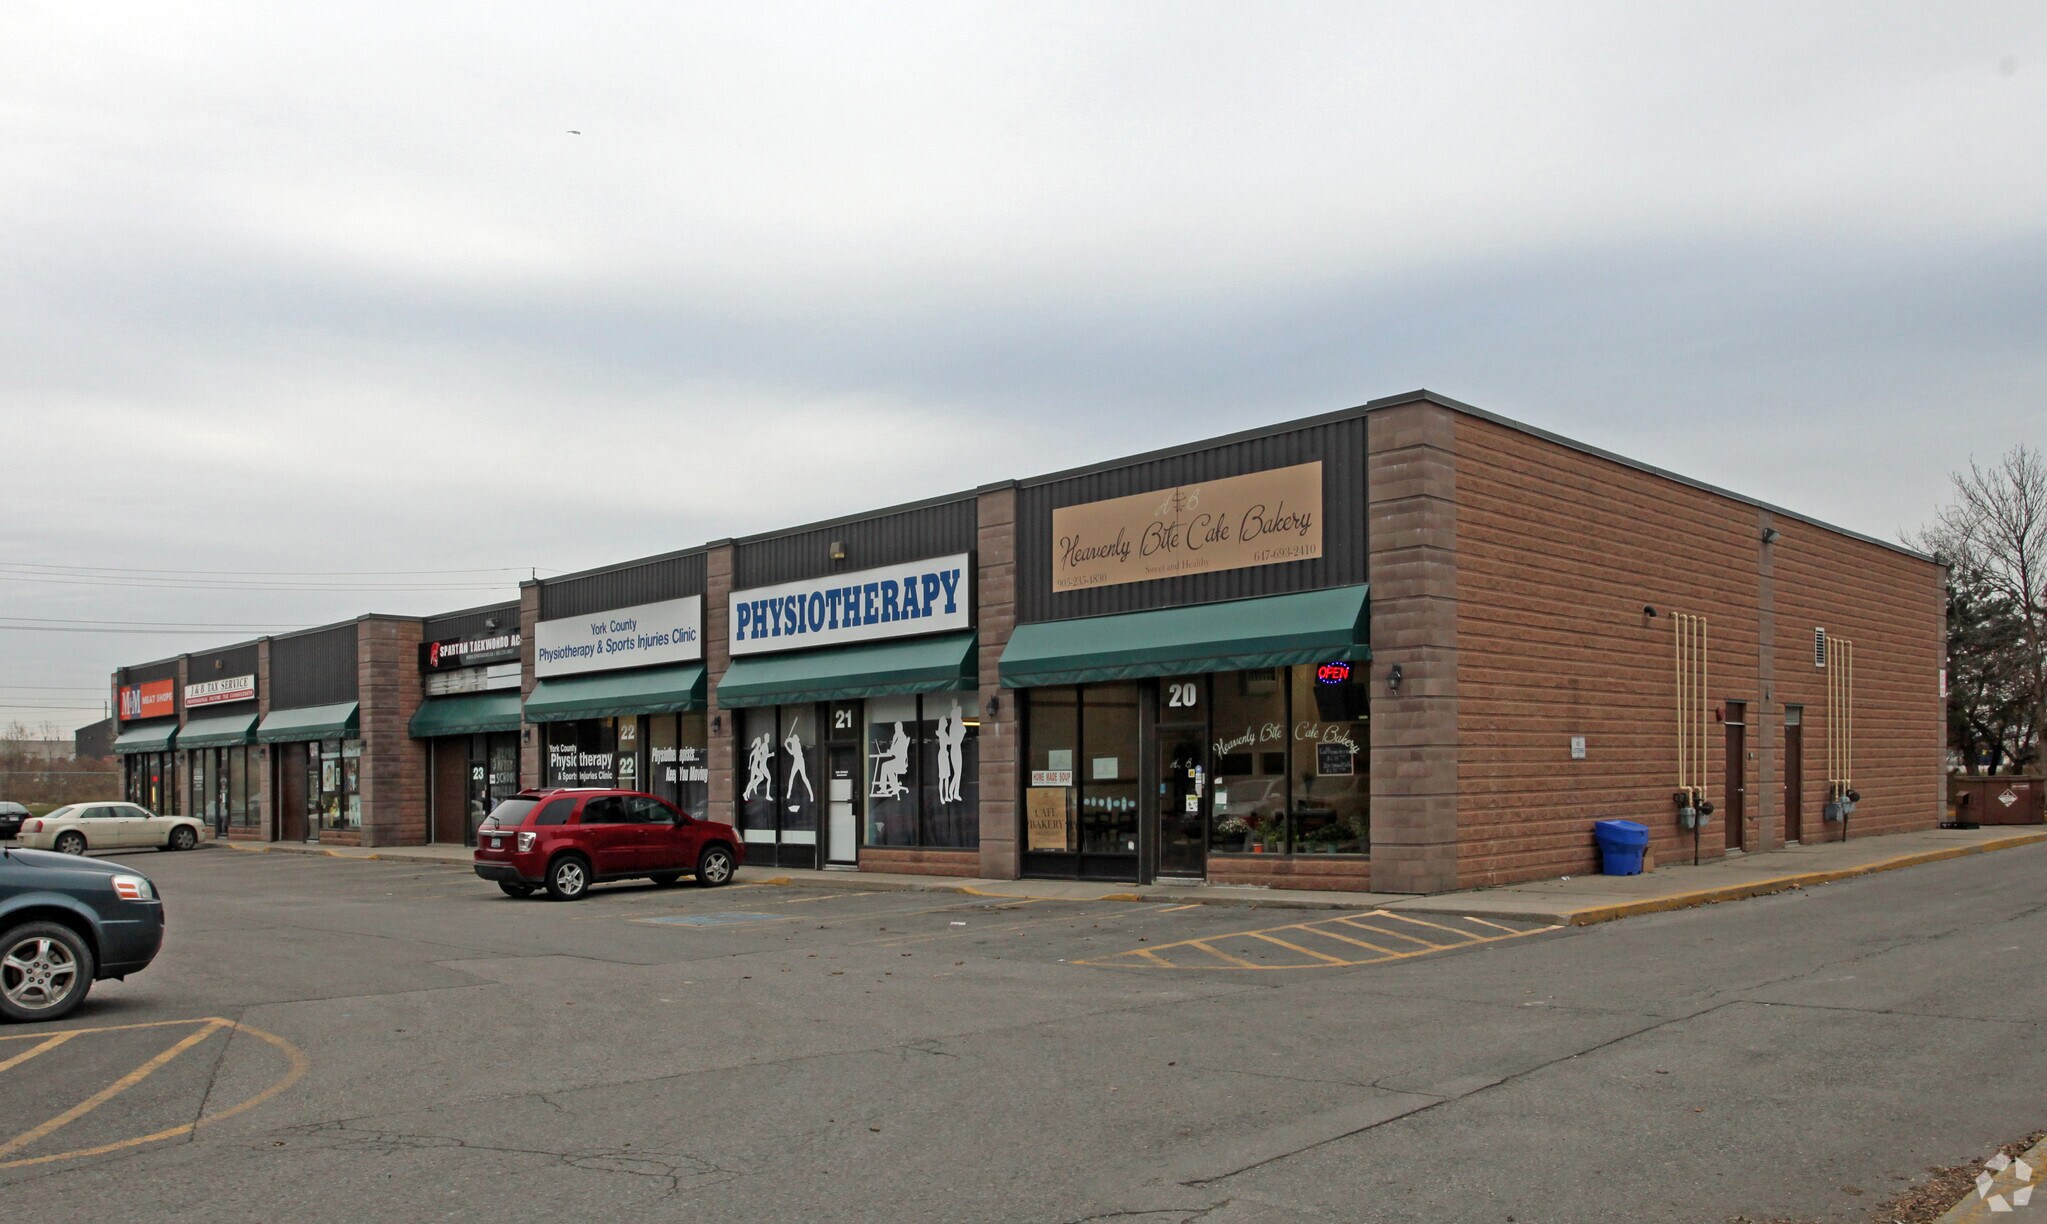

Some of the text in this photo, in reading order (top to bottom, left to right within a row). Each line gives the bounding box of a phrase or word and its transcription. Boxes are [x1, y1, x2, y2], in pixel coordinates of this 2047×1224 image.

[1059, 526, 1131, 571] Heavenly
[1138, 521, 1187, 559] Bite
[1238, 500, 1312, 545] Bakery
[1166, 560, 1180, 571] and
[736, 568, 960, 641] PHYSIOTHERAPY
[590, 618, 637, 636] York County
[439, 641, 468, 658] SPARTAN
[469, 635, 509, 653] TAEKWONDO
[510, 634, 522, 646] AC
[539, 627, 697, 663] Physiotherapy & Sports Injuries Clinic
[1318, 665, 1349, 680] OPEN
[207, 682, 219, 692] TAX
[221, 677, 249, 690] SERVICE
[142, 694, 156, 705] MEAT
[156, 692, 173, 703] SHOPS
[1168, 683, 1197, 707] 20
[835, 709, 852, 729] 21
[620, 724, 635, 740] 22
[560, 744, 577, 753] County
[1213, 726, 1255, 760] Heavenly
[1259, 722, 1283, 742] Bite
[1321, 724, 1360, 755] Bakery
[472, 766, 484, 780] 23
[619, 757, 634, 774] 22
[557, 772, 562, 780] &
[579, 771, 598, 782] Injuries
[598, 770, 613, 780] Clinic
[679, 766, 689, 781] You
[1033, 772, 1071, 781] HOME MADE SOUP
[1034, 807, 1057, 817] CAFE
[1029, 819, 1064, 829] BAKERY
